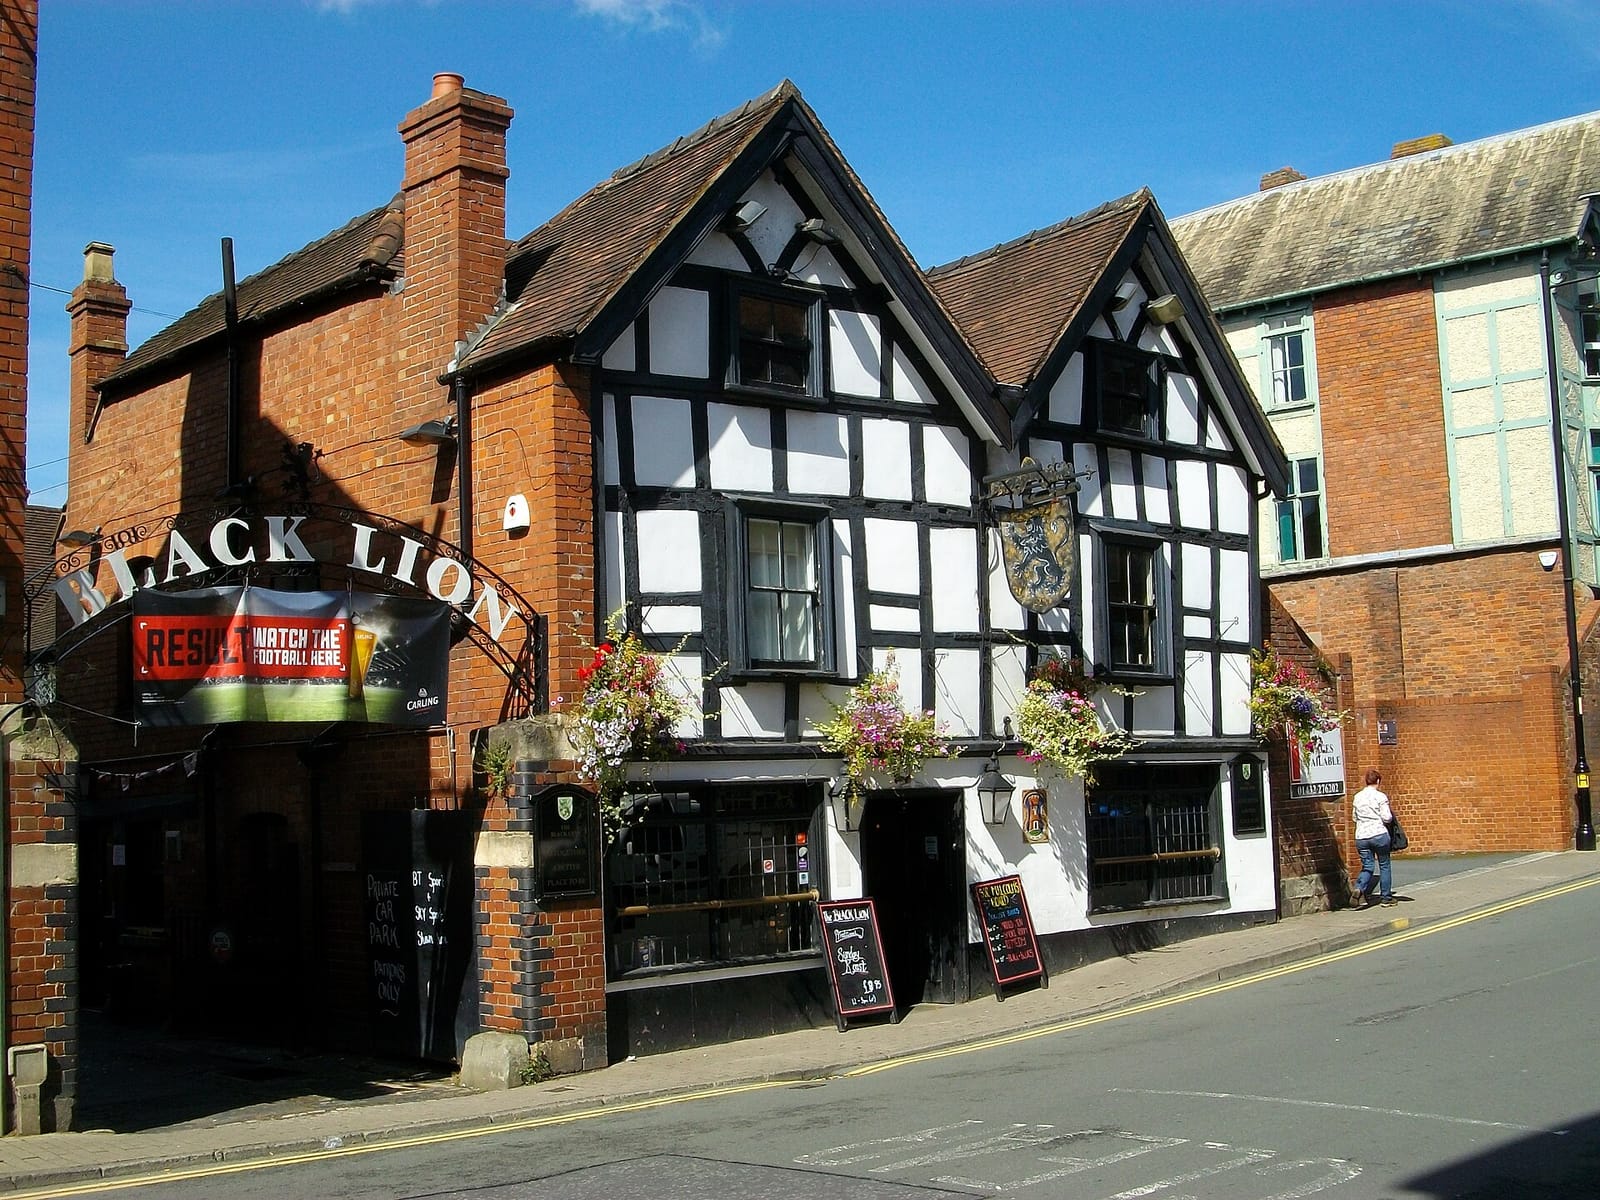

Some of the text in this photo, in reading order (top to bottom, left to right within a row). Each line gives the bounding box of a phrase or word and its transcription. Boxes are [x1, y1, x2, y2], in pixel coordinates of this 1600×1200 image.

[49, 516, 522, 641] BLACK LION
[147, 627, 250, 667] RESULT
[253, 627, 341, 648] WATCH THE
[253, 649, 341, 666] FOOTBALL HERE
[407, 696, 439, 711] CARLING
[1311, 756, 1341, 767] AILABLE
[368, 874, 399, 899] PRIVATE
[412, 871, 422, 886] BT
[376, 899, 395, 922] CAR
[369, 923, 400, 948] PARK
